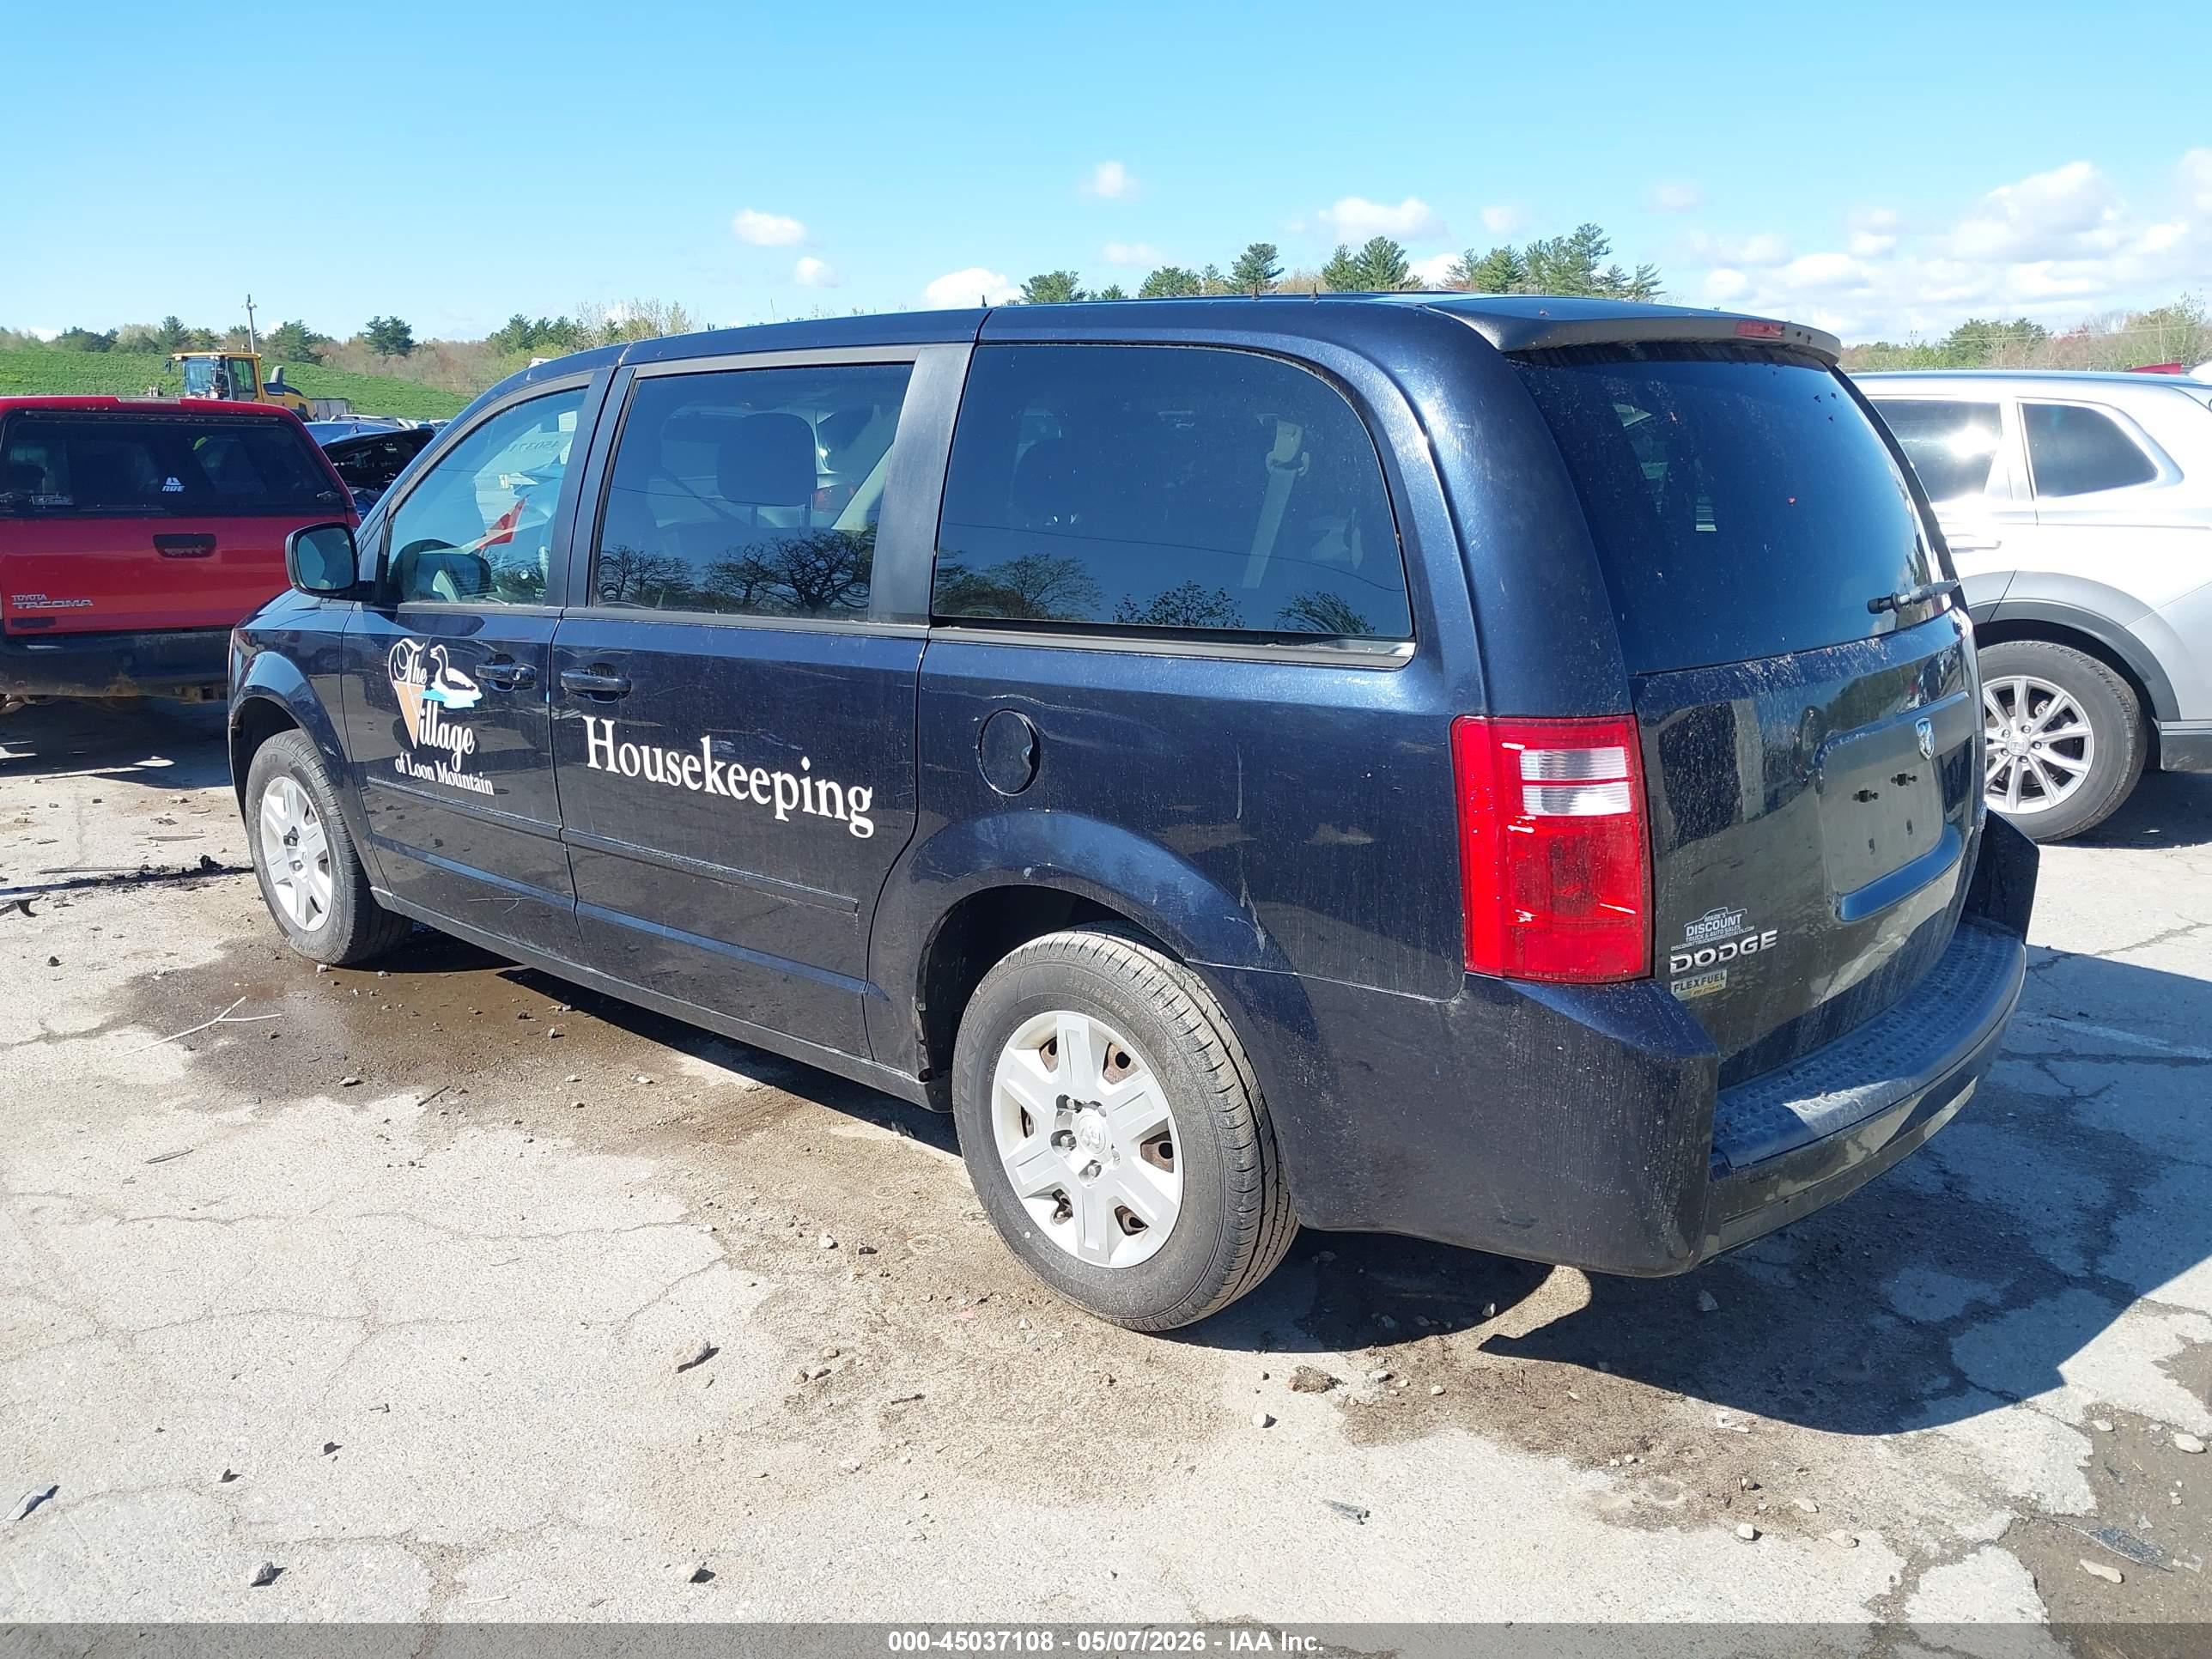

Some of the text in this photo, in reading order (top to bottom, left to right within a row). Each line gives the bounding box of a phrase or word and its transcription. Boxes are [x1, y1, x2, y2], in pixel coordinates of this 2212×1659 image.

[11, 593, 48, 602] TOYOTA
[12, 599, 94, 609] TACOMA
[388, 638, 428, 688] The
[393, 680, 477, 772] Village
[394, 751, 495, 796] of Loon Mountain
[582, 715, 874, 838] Housekeeping
[1686, 914, 1742, 937] DISCOUNT
[1686, 933, 1705, 943] TRUCK
[1710, 928, 1724, 938] AUTO
[1724, 924, 1741, 933] SALES
[1669, 929, 1778, 974] DODGE
